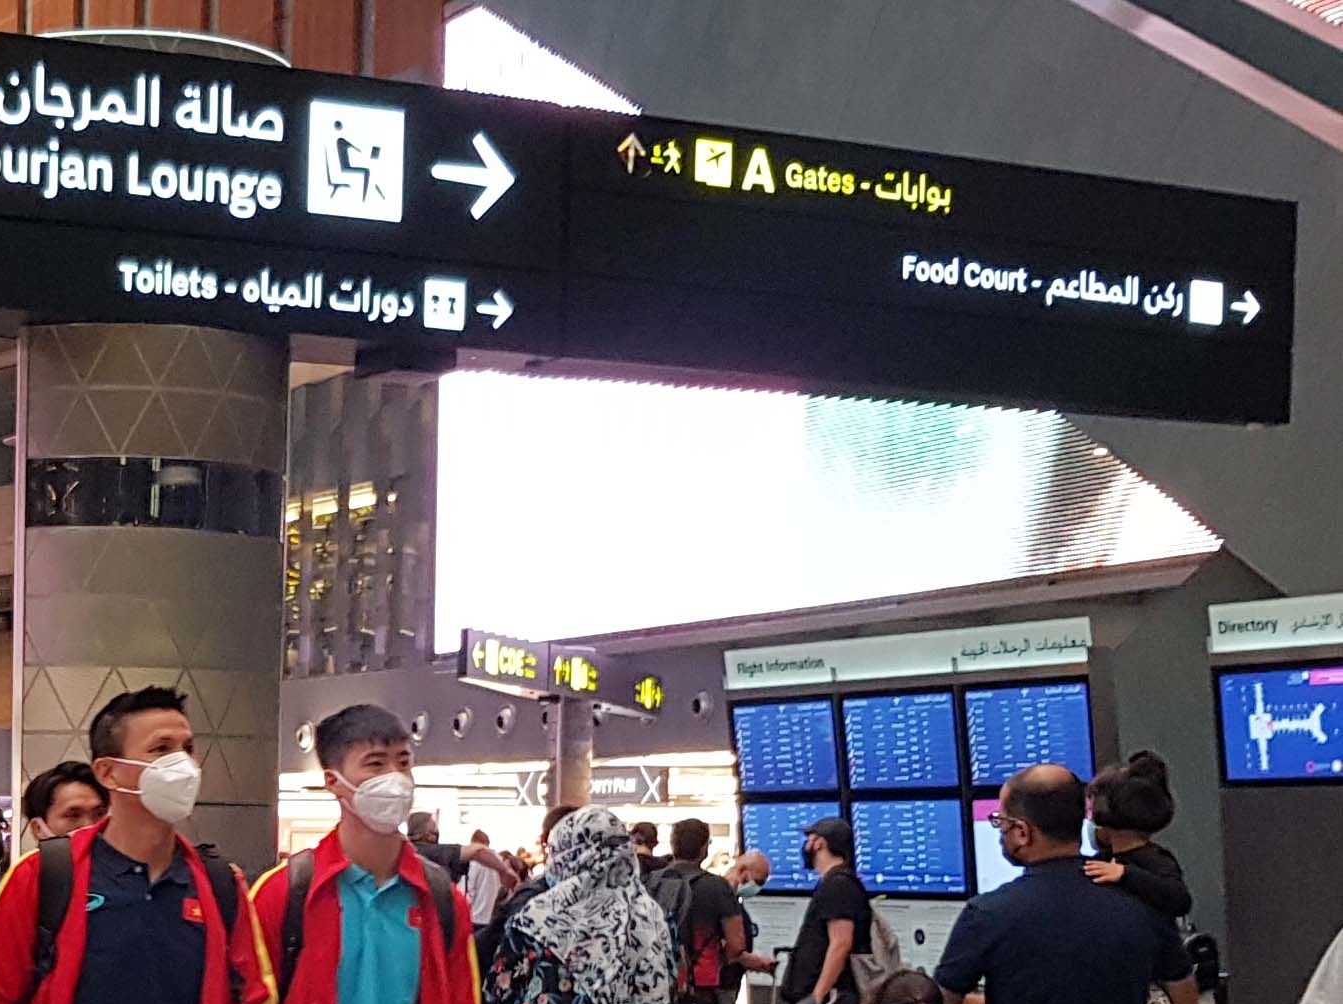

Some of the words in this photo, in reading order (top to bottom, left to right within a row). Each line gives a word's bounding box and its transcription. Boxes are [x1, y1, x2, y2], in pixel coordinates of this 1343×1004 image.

[174, 83, 285, 142] صالة
[126, 152, 283, 219] Lounge
[741, 148, 776, 194] A
[784, 161, 856, 195] Gates
[874, 171, 952, 214] بوابات
[119, 259, 218, 300] Toilets
[242, 266, 323, 313] المياه
[902, 255, 960, 286] Food
[963, 262, 1028, 293] Court
[1045, 270, 1139, 306] المطاعم
[329, 279, 415, 323] دورات
[1143, 281, 1184, 317] ركن
[1218, 619, 1278, 634] Directory
